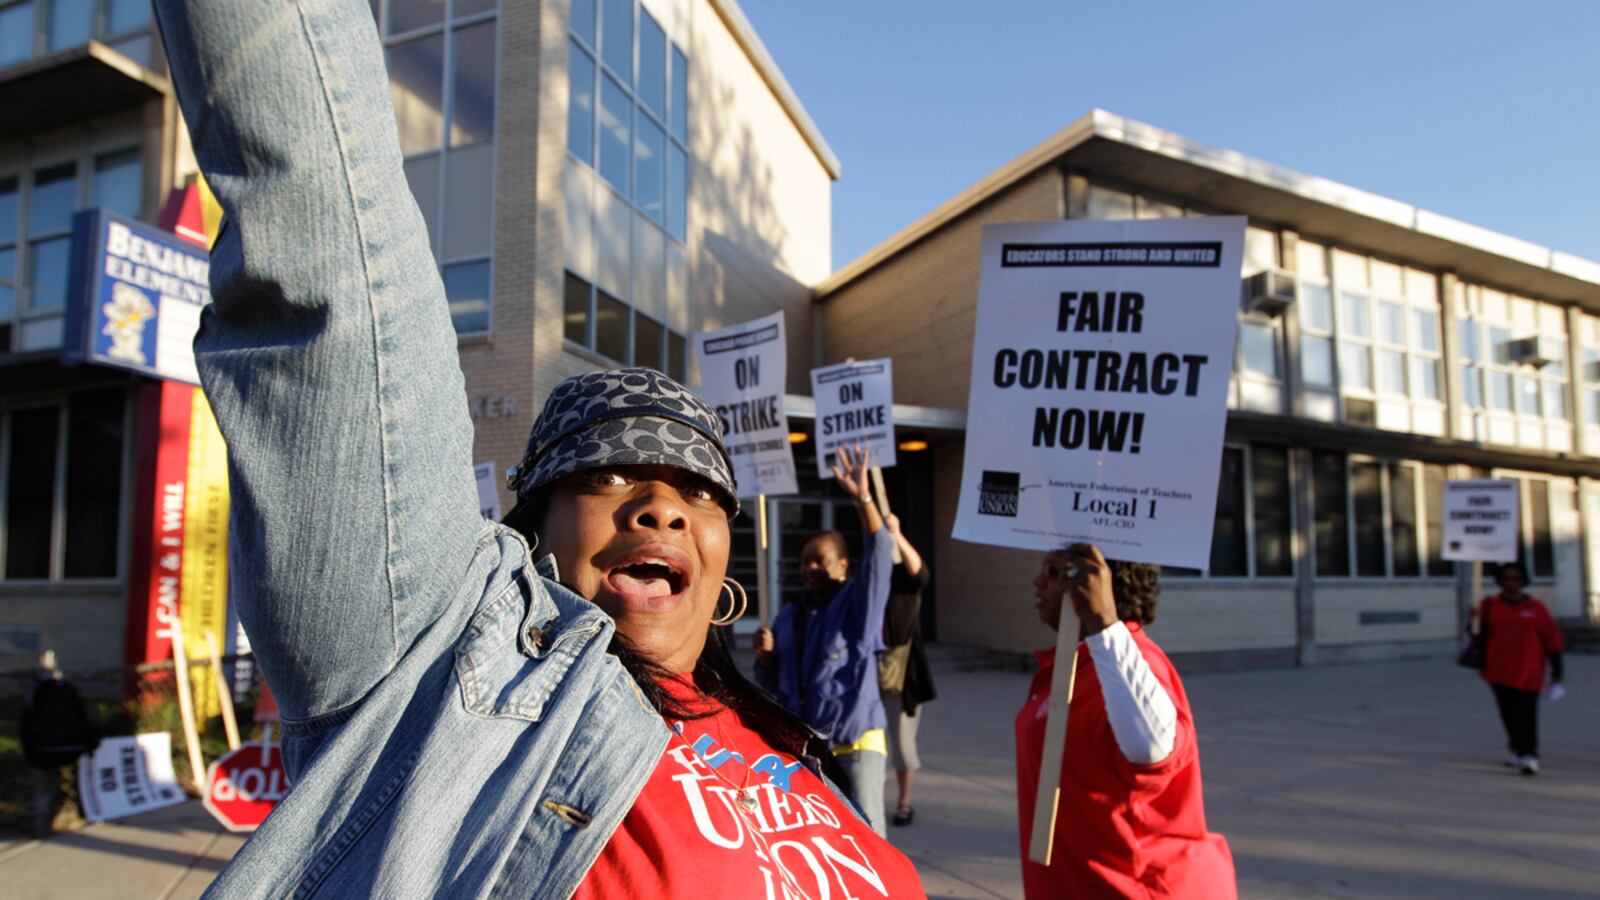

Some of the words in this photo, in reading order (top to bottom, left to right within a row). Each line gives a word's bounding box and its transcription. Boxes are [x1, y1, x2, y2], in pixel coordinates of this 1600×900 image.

[1007, 250, 1066, 263] EDUCATORS
[1067, 250, 1101, 262] STAND
[1103, 249, 1148, 262] STRONG
[1149, 249, 1172, 262] AND
[1174, 249, 1216, 262] UNITED
[1057, 291, 1145, 334] FAIR
[735, 354, 760, 390] ON
[993, 348, 1209, 397] CONTRACT
[839, 382, 863, 405] ON
[716, 395, 780, 437] STRIKE
[823, 405, 886, 435] STRIKE
[1032, 407, 1145, 454] NOW!
[1047, 479, 1088, 490] American
[1089, 482, 1138, 496] Federation
[1139, 487, 1150, 496] of
[1152, 489, 1193, 500] Teachers
[162, 482, 184, 532] WILL
[979, 500, 1018, 514] UNION
[1071, 491, 1137, 517] Local
[1147, 500, 1157, 519] 1
[1092, 517, 1136, 530] AFL-CIO
[162, 537, 182, 547] I
[160, 553, 181, 571] &
[213, 768, 292, 801] TOP
